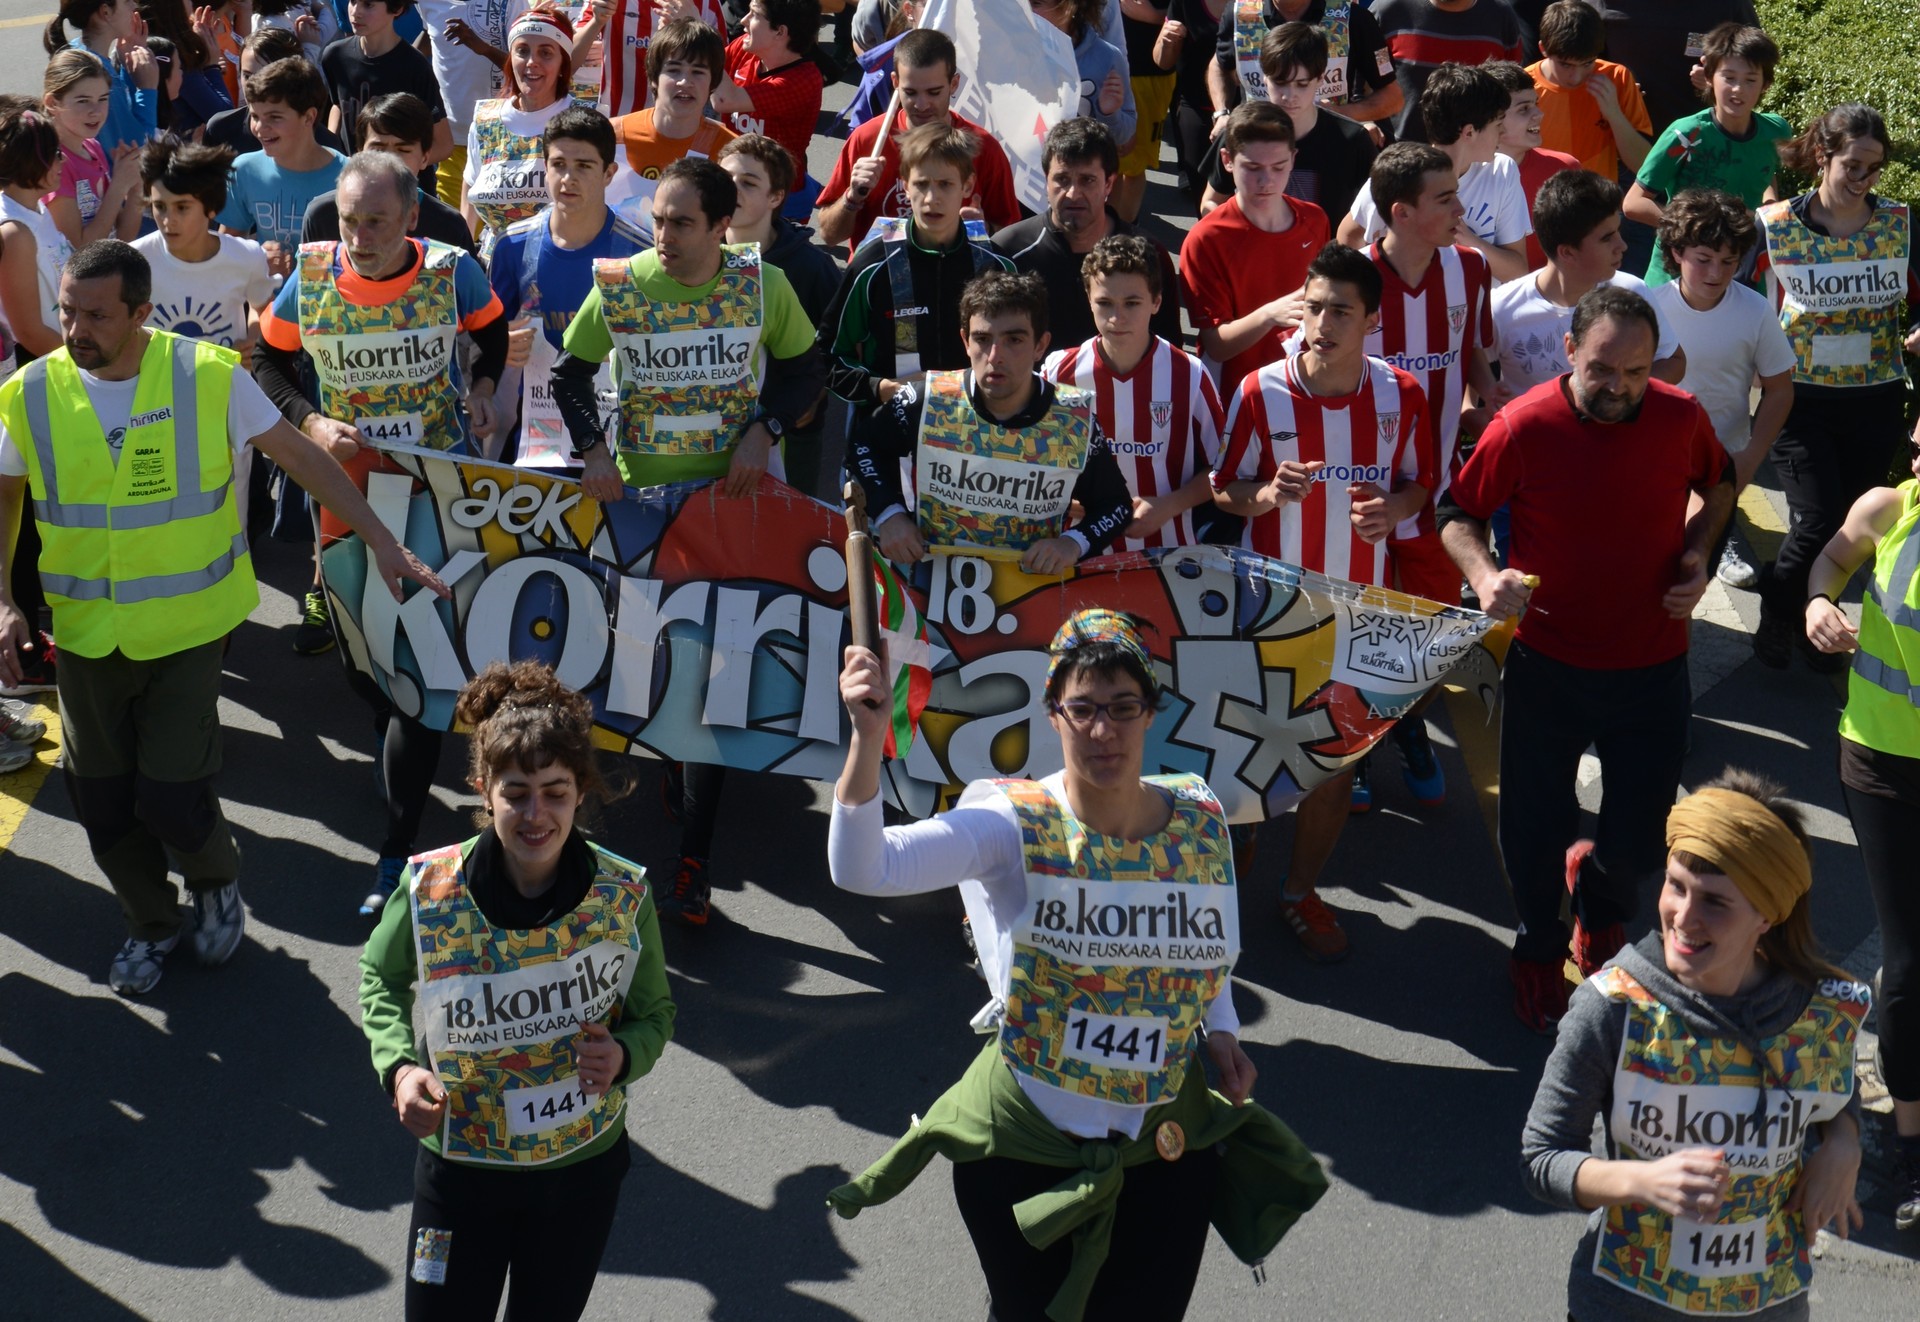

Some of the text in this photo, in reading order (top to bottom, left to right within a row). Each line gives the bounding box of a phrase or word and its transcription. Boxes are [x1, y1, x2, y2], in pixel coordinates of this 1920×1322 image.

[1325, 8, 1349, 19] aek
[477, 190, 550, 201] EMAN EUSKARA
[726, 252, 760, 270] aek
[893, 305, 930, 318] LEGEA
[1819, 294, 1865, 307] EUSKARA
[317, 334, 446, 372] 18.korrika
[350, 368, 406, 384] EUSKARA
[407, 355, 446, 379] ELKARRI
[655, 370, 708, 382] EUSKARA
[363, 420, 413, 441] 1441
[134, 447, 155, 456] GARA
[126, 486, 173, 497] ARDURADUNA
[927, 458, 1067, 502] 18.korrika
[450, 478, 583, 544] aek
[928, 482, 1061, 516] EMAN EUSKARA ELKARRI
[926, 552, 1019, 636] 18.
[1359, 652, 1405, 675] 18.korrika
[1176, 787, 1215, 804] aek
[1031, 886, 1227, 942] 18.korrika
[1031, 931, 1227, 963] EMAN EUSKARA ELKARRI
[440, 953, 627, 1030] 18.korrika
[1819, 979, 1871, 1005] aek
[447, 1030, 499, 1046] EMAN
[503, 1013, 581, 1042] EUSKARA
[1070, 1016, 1163, 1065] 1441
[521, 1089, 589, 1124] 1441
[1627, 1094, 1821, 1150] 18.korrik
[1630, 1133, 1672, 1157] EMA
[1723, 1152, 1771, 1171] KARA
[1689, 1230, 1757, 1270] 1441
